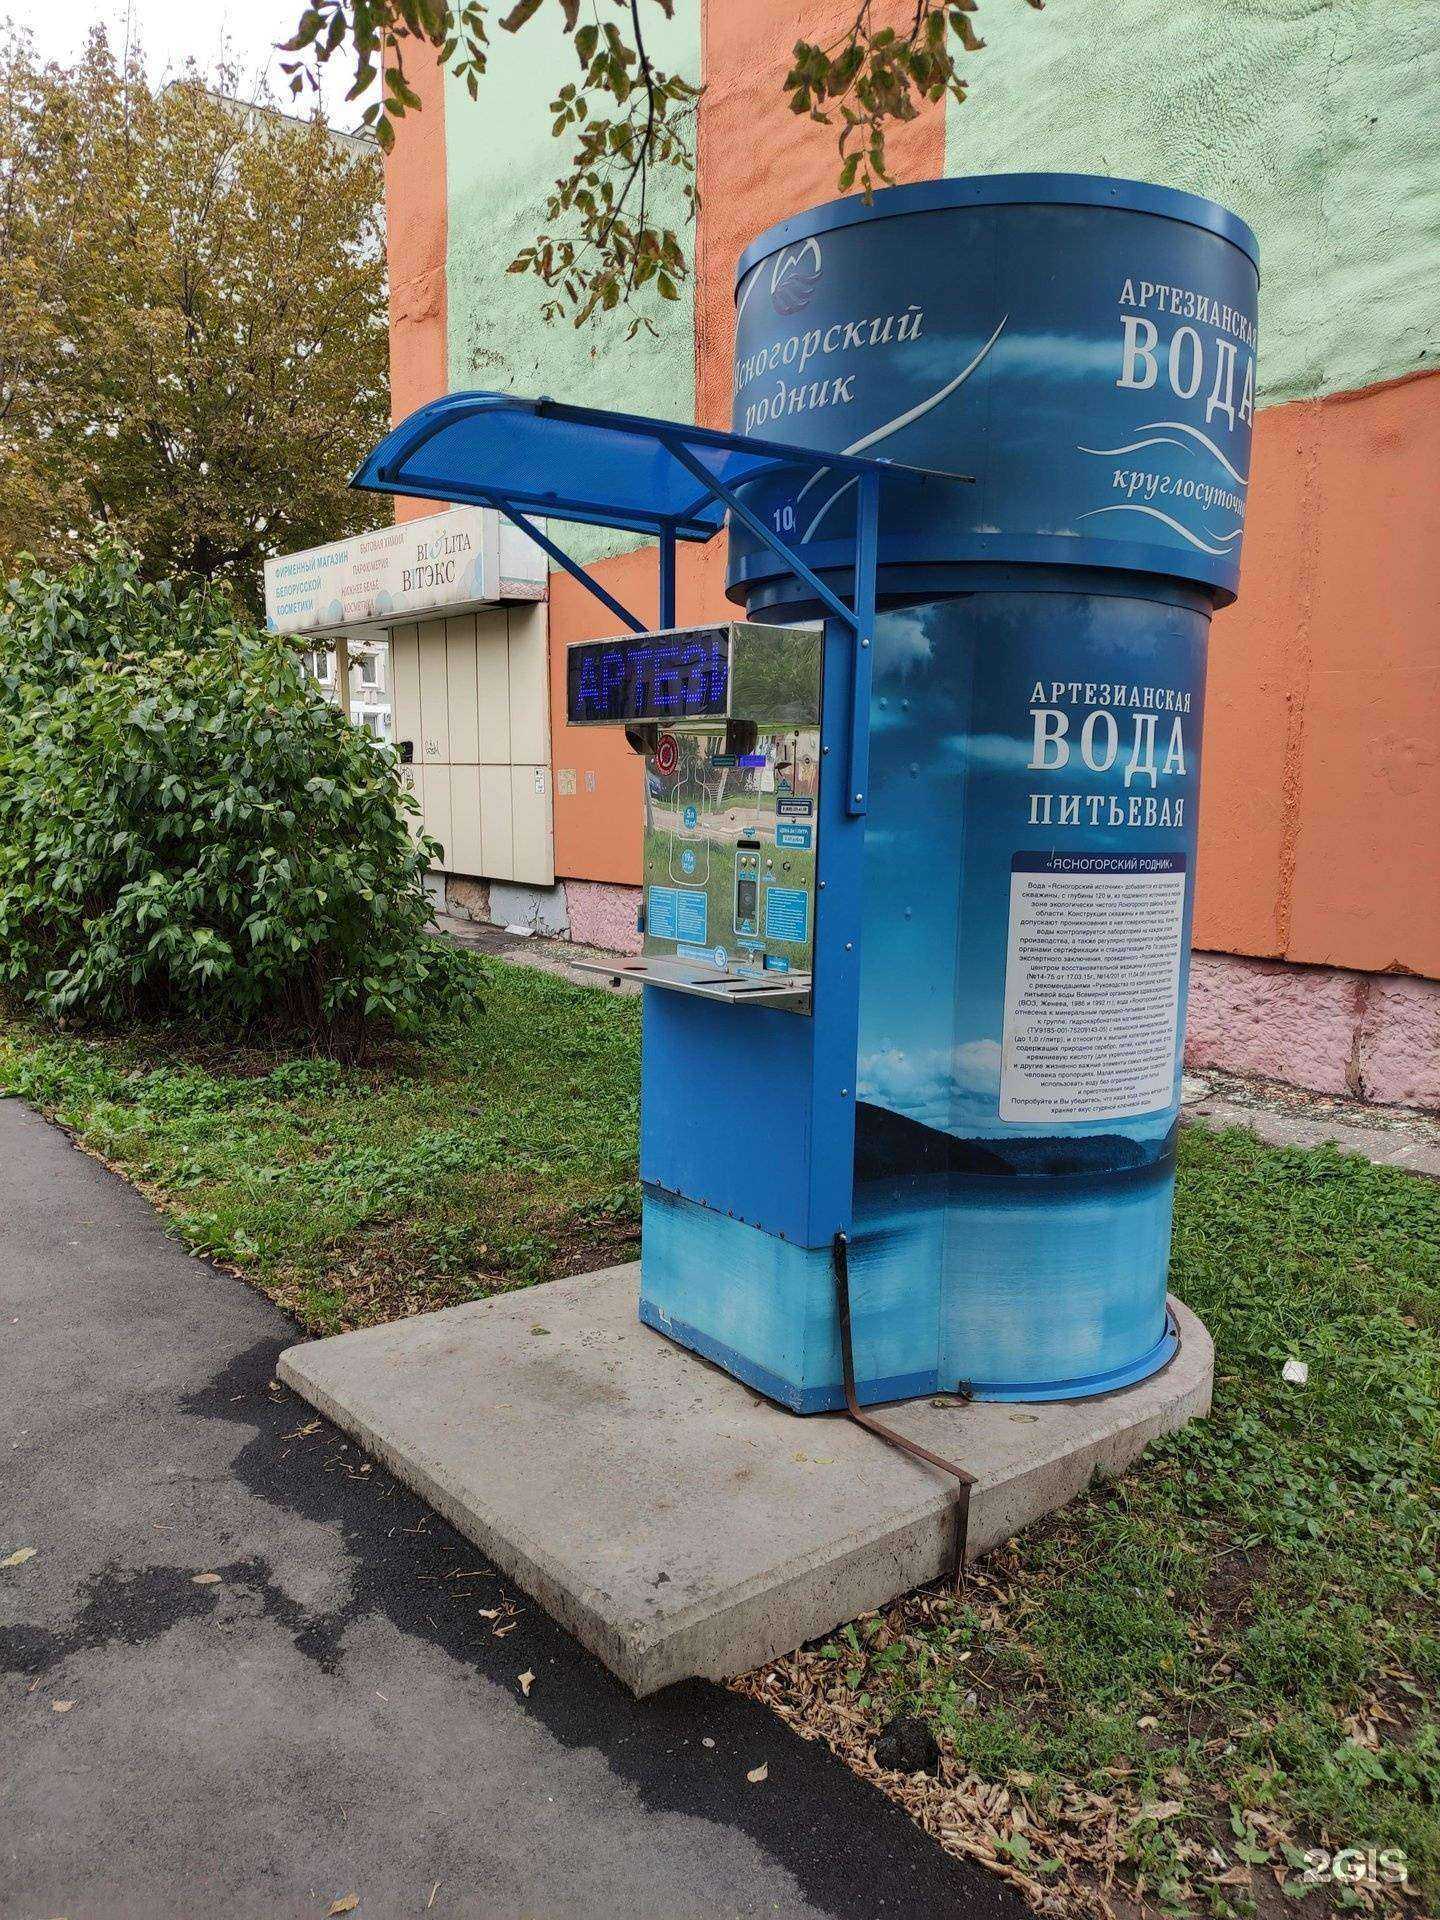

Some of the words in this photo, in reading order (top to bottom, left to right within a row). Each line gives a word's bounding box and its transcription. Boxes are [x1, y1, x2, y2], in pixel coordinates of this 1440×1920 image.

[1115, 315, 1256, 432] ВОДА
[745, 373, 856, 435] родник
[275, 555, 317, 579] ФИРМЕННЫЙ
[317, 551, 349, 570] МАГАЗИН
[275, 575, 322, 598] БЕЛОРУССКОЙ
[276, 599, 314, 616] КОСМЕТИКИ
[1030, 681, 1192, 713] АРТЕЗИАНСКАЯ
[1027, 709, 1187, 788] ВОДА
[1028, 794, 1185, 828] ПИТЬЕВАЯ
[1046, 857, 1139, 870] «ЯСНОГОРСКИЙ
